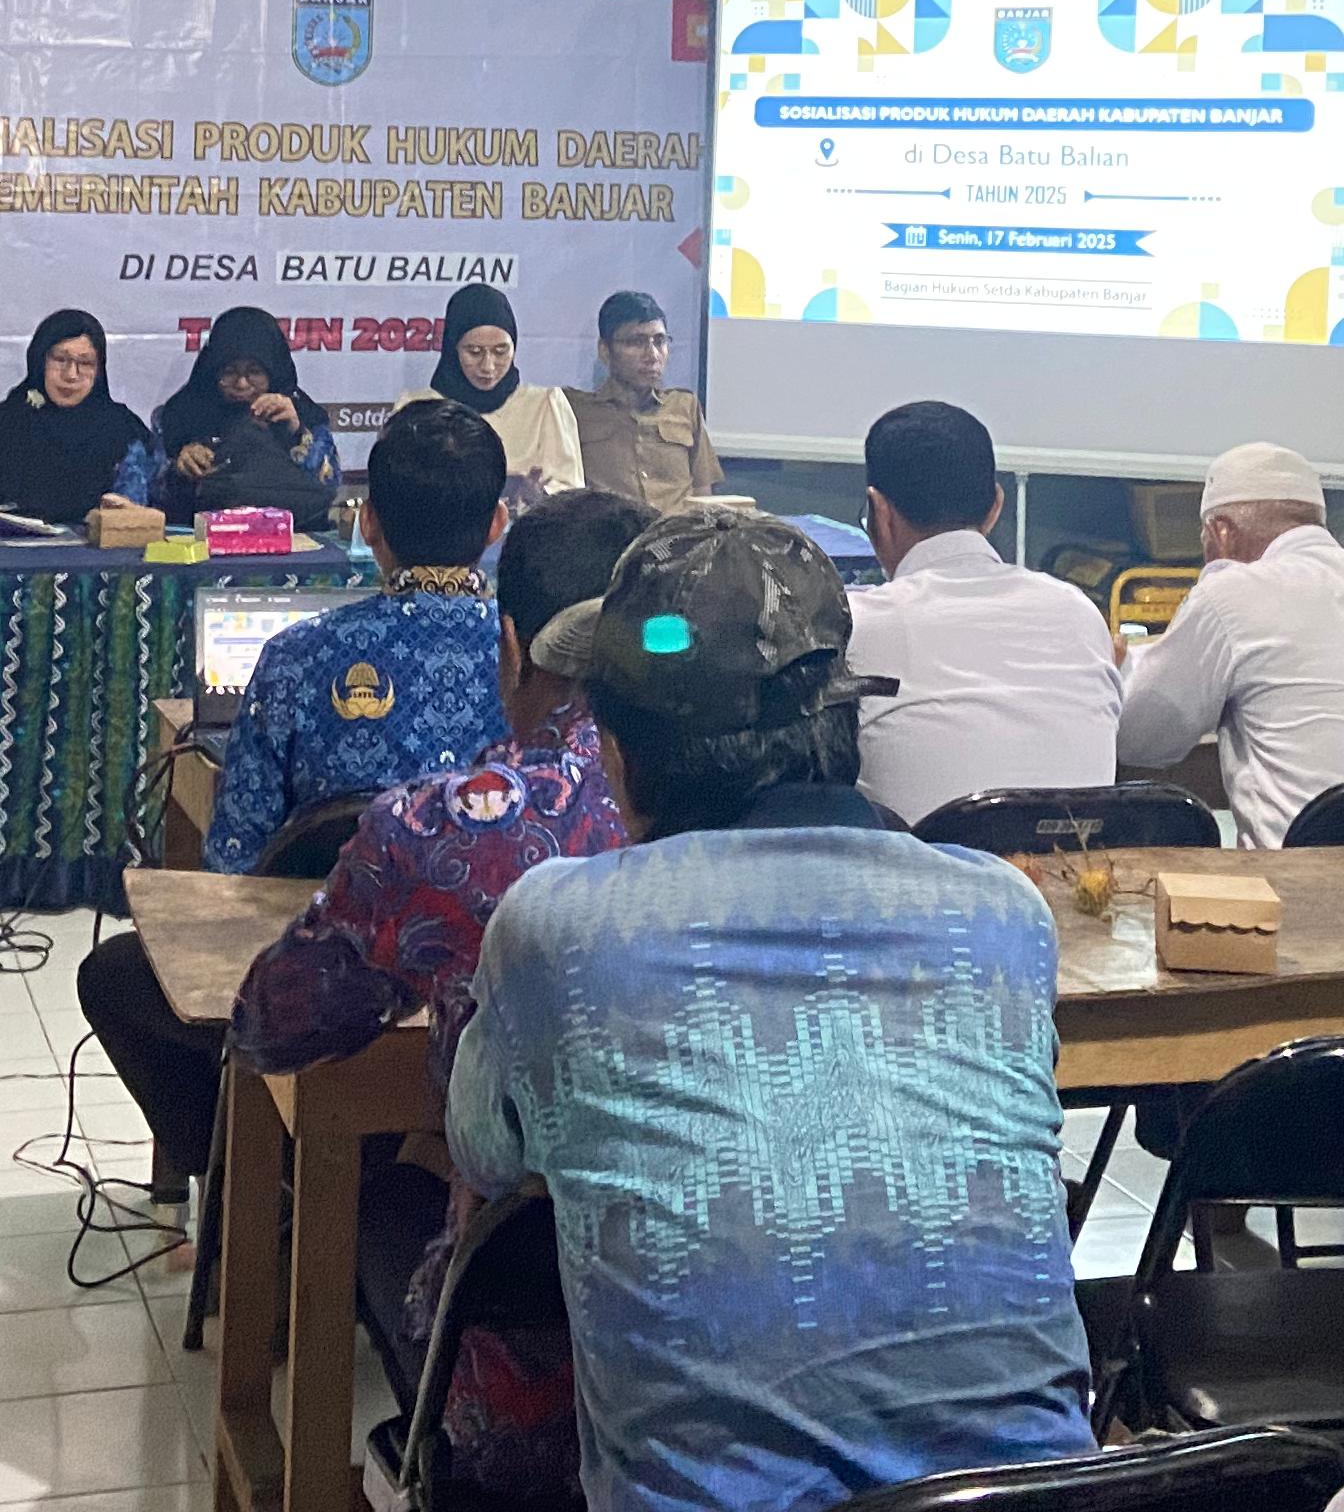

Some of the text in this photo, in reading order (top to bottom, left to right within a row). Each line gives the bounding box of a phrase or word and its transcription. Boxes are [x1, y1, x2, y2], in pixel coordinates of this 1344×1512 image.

[779, 105, 1284, 126] SOSIALISASI PRODUK HUKUM DAERAH KABUPATEN BANJAR
[193, 120, 372, 166] PRODUK
[386, 125, 539, 167] HUKUM
[904, 143, 1130, 168] di Desa Batu Balian
[258, 176, 503, 220] KABUPATEN
[521, 181, 675, 223] BANJAR
[965, 184, 1068, 205] TAHUN 2025
[938, 229, 1117, 250] Senin, 17 Februari 2025
[119, 254, 514, 284] DI DESA BATU BALIAN
[884, 279, 1147, 303] Bagian Hukum Setda Kabupaten Banjar
[177, 316, 344, 353] TUN
